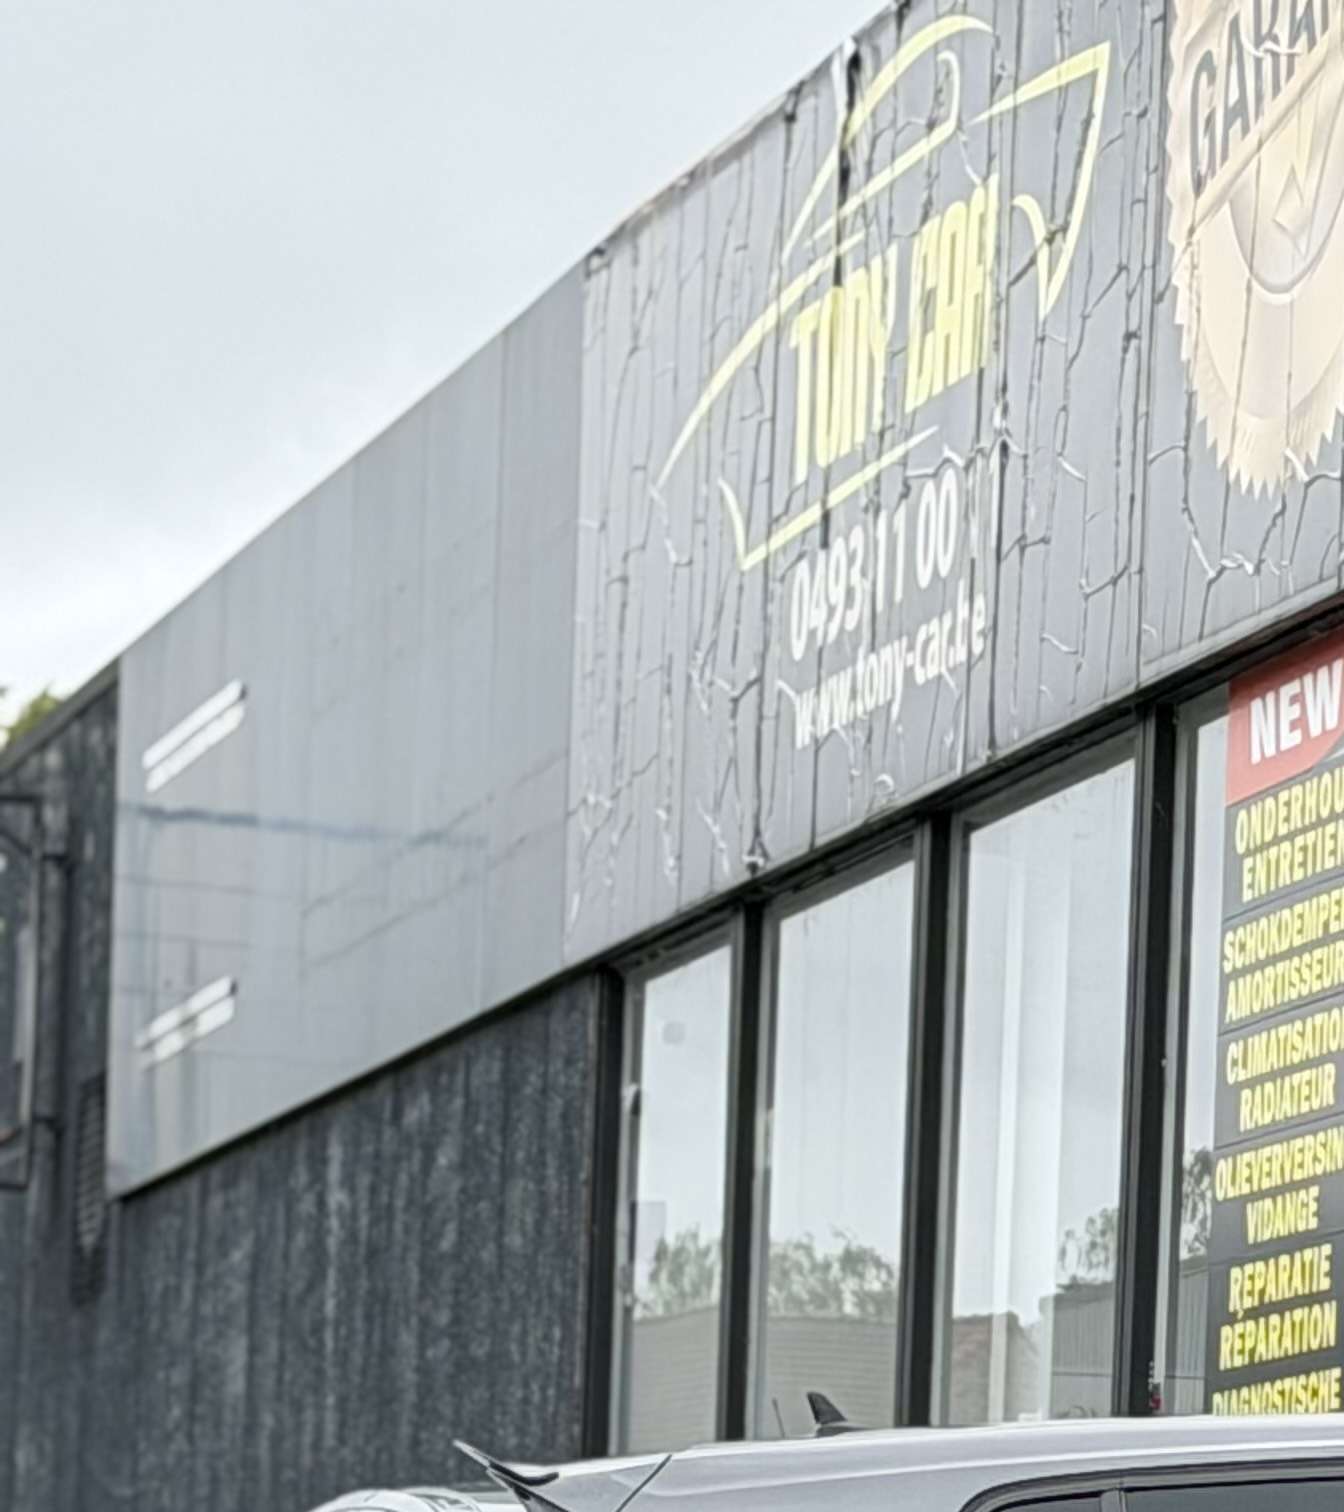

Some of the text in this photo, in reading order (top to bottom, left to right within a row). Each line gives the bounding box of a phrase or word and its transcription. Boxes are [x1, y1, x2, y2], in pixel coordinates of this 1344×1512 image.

[789, 242, 899, 484] TONY
[790, 522, 868, 661] 0493
[915, 467, 959, 590] 00
[1250, 658, 1344, 766] NEW
[1239, 1062, 1337, 1133] RADIATEUR
[1246, 1185, 1320, 1245] VIDANGE
[1227, 1243, 1333, 1313] REPARATIE
